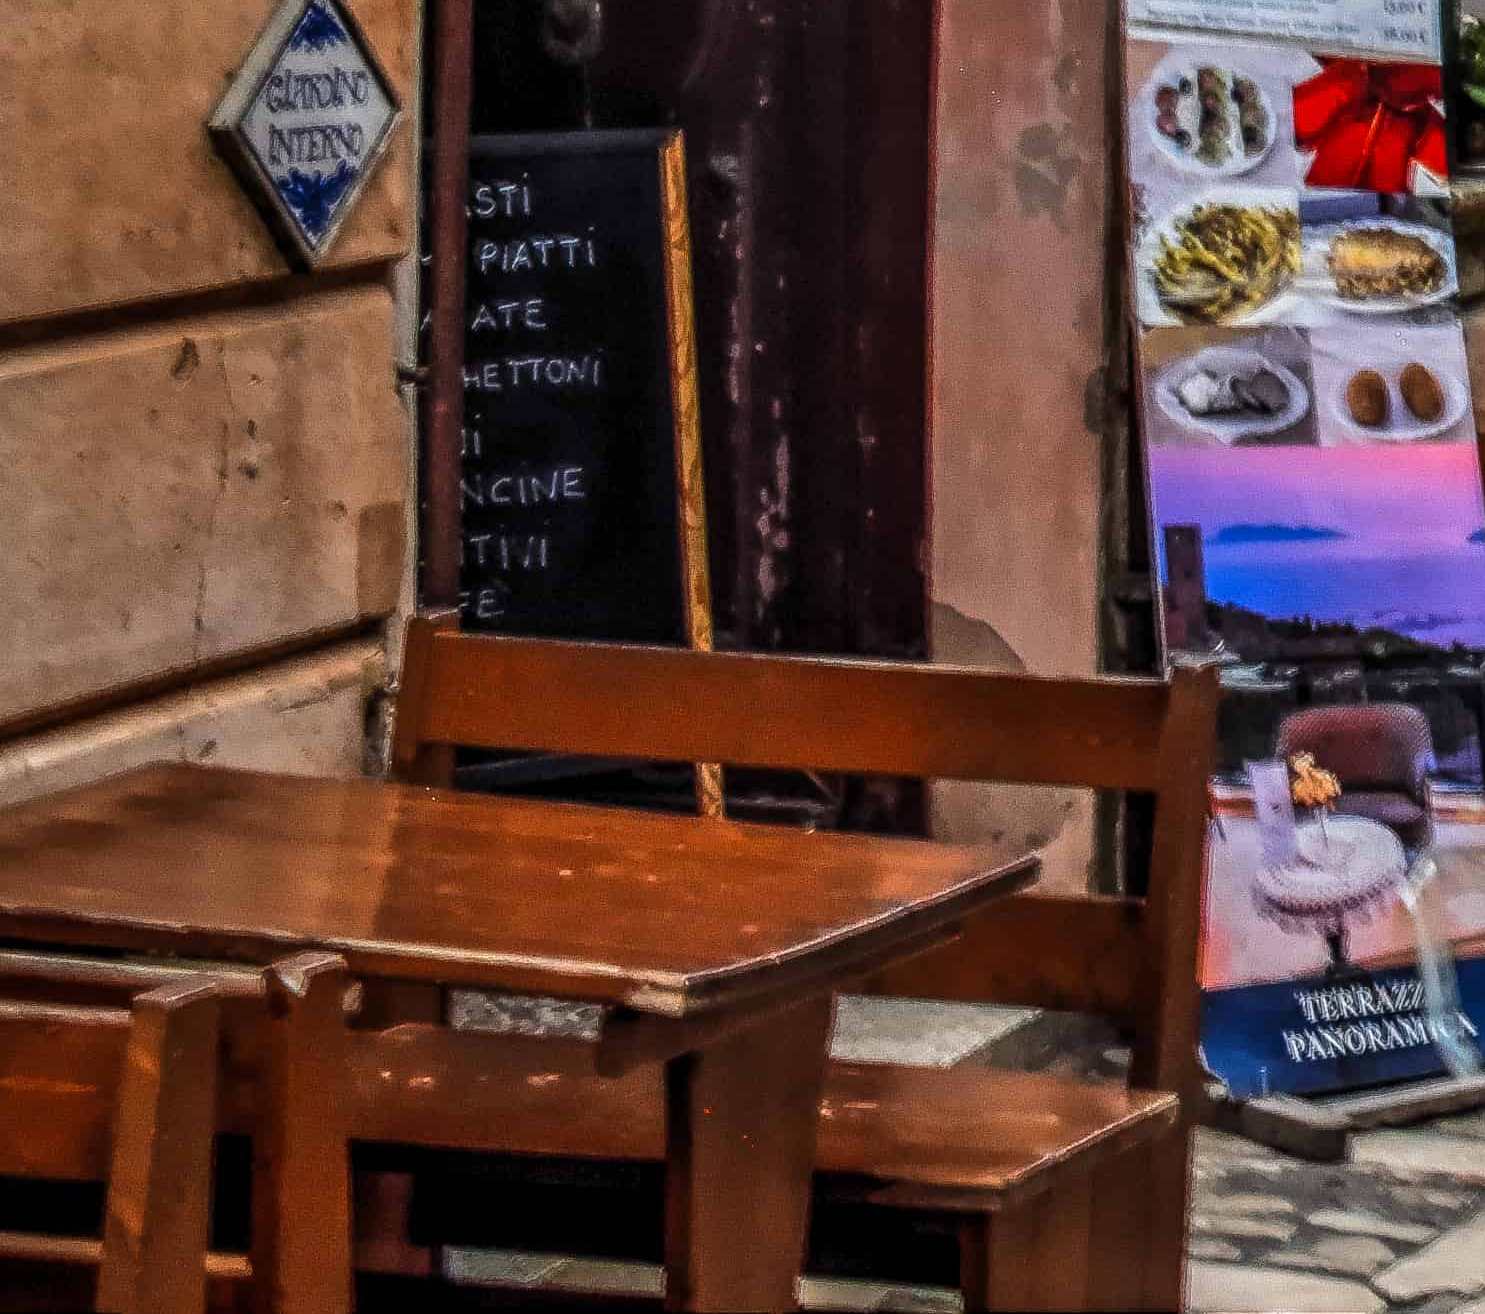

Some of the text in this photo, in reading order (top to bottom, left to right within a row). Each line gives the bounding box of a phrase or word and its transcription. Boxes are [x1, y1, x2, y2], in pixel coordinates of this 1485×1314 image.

[480, 226, 596, 275] PIATTI
[461, 348, 604, 389] HETTONI
[460, 466, 585, 511] NCINE
[1297, 979, 1425, 1023] TERRAZZ
